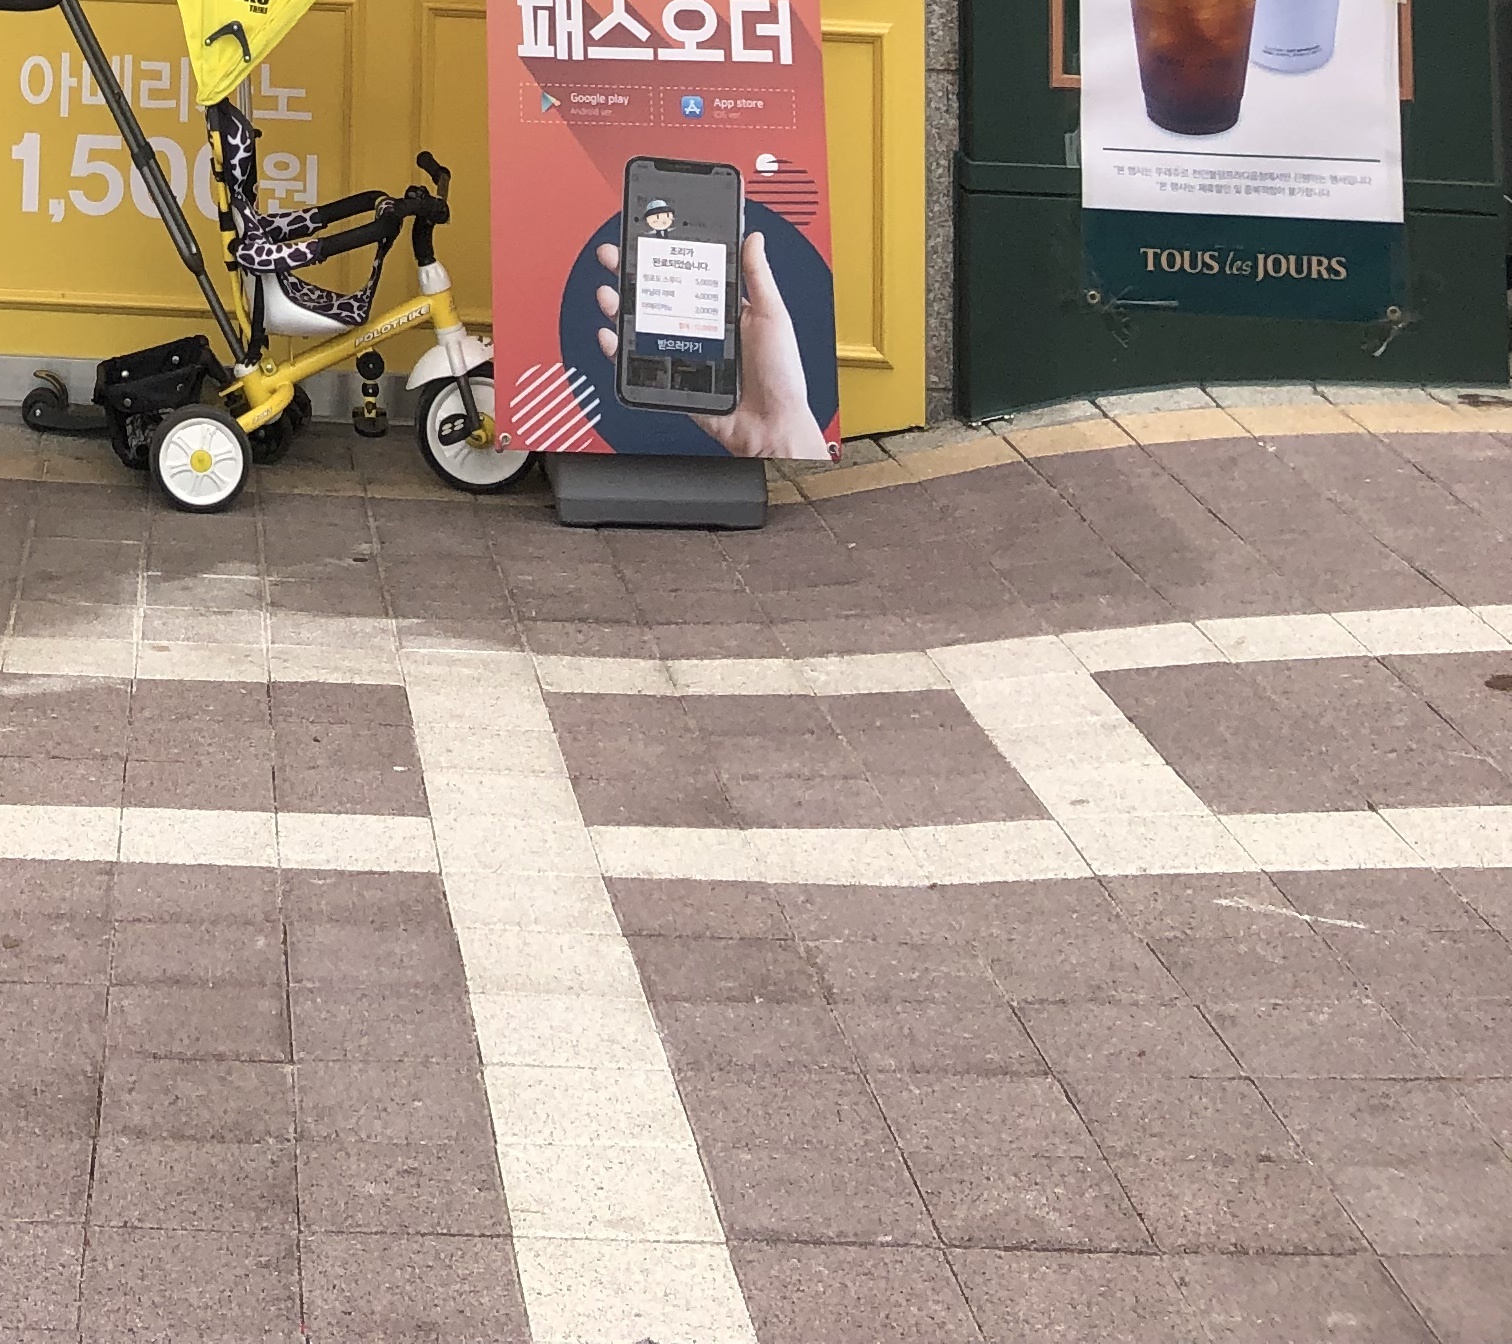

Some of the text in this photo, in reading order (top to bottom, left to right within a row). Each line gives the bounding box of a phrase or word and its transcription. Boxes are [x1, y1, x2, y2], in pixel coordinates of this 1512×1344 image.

[20, 52, 313, 123] 아메리노
[570, 92, 630, 106] Google play
[713, 98, 764, 109] App store
[1140, 247, 1348, 283] TOUS les JOURS
[354, 303, 431, 347] POLOTRIKE
